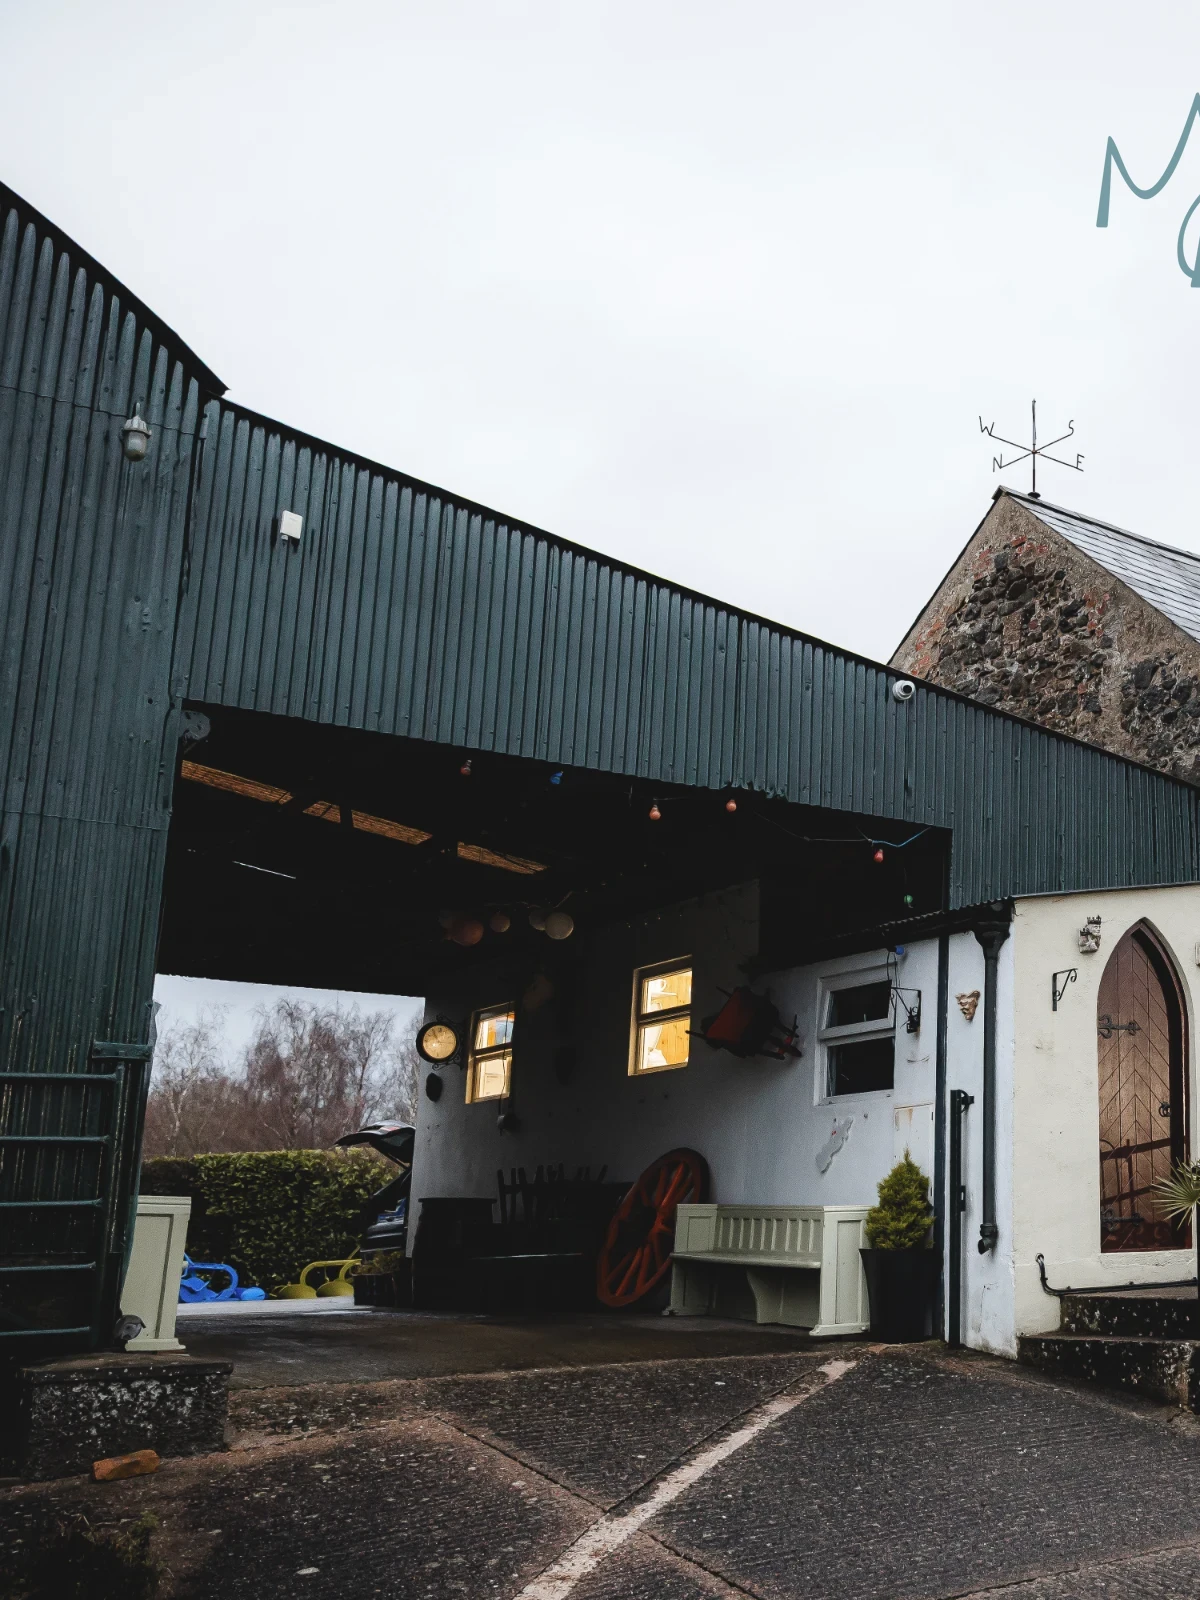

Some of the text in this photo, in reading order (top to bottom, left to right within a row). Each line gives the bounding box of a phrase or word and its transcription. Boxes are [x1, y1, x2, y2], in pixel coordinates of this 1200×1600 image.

[979, 415, 995, 436] W
[1068, 419, 1075, 436] S
[992, 453, 1003, 473] N
[1076, 453, 1085, 472] E
